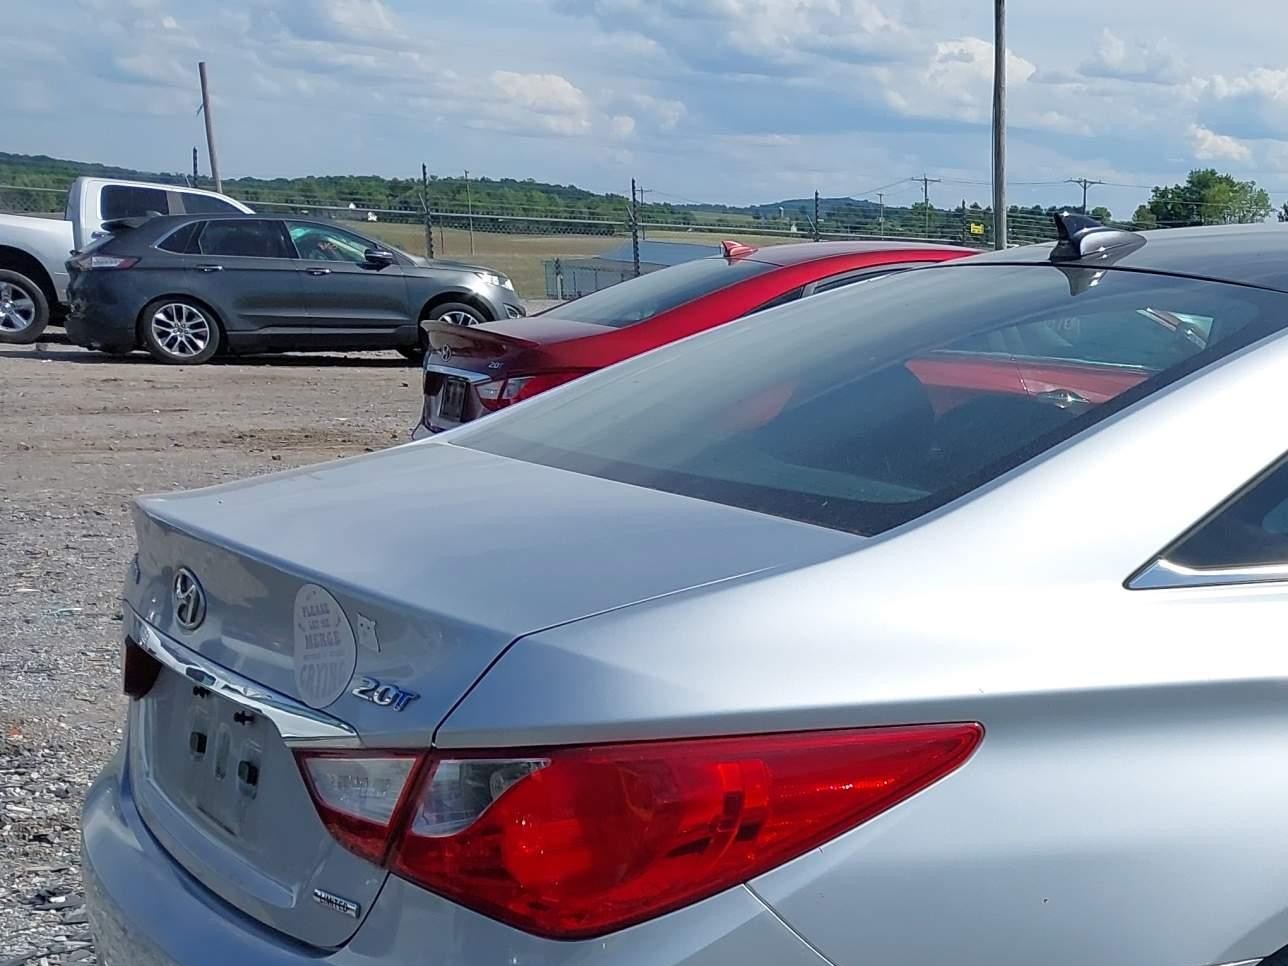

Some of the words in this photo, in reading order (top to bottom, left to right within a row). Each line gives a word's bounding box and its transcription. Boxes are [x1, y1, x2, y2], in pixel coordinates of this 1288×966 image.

[302, 603, 331, 617] PLEASE
[305, 631, 342, 649] MERGE
[300, 662, 346, 697] CRYING
